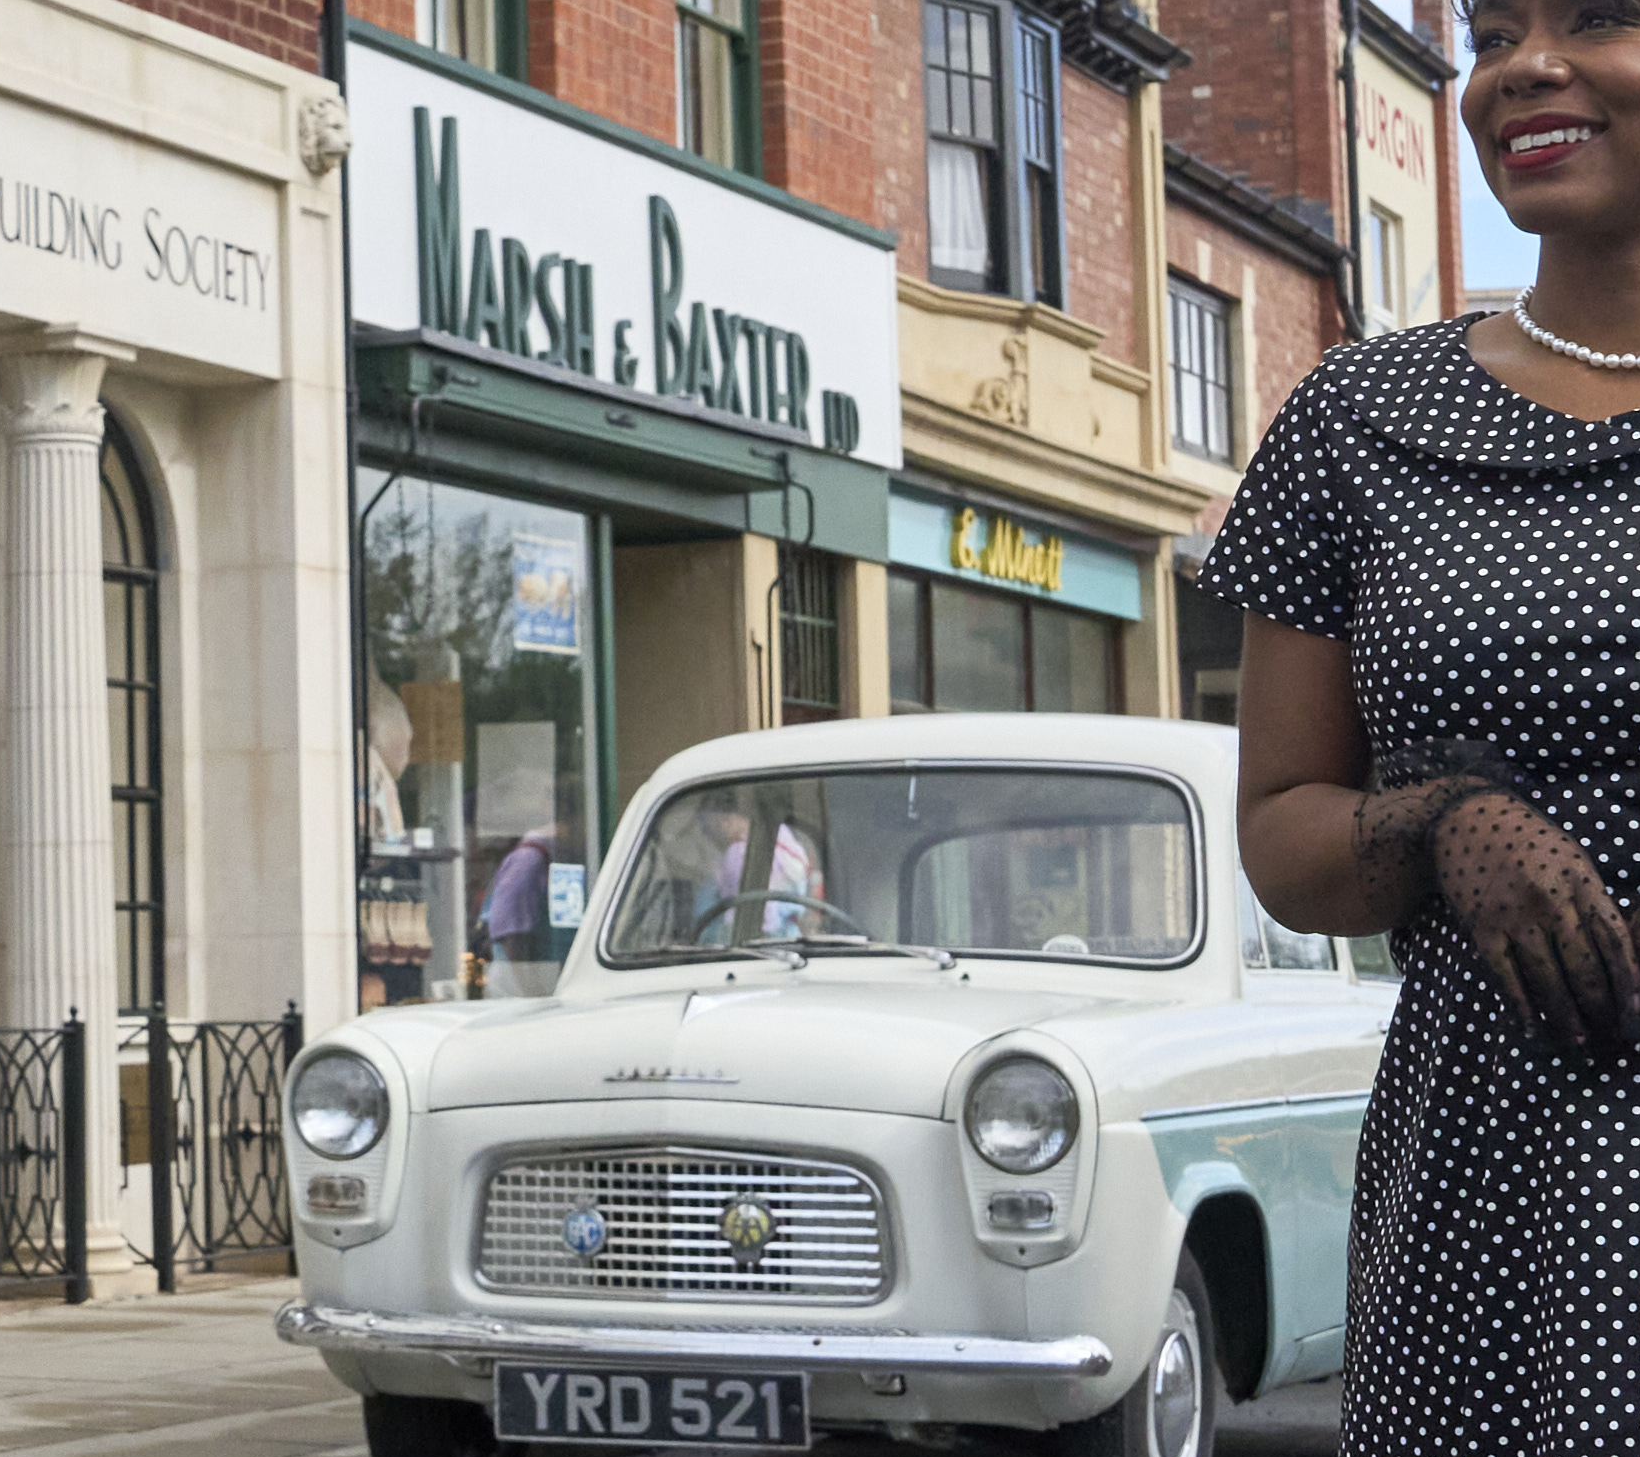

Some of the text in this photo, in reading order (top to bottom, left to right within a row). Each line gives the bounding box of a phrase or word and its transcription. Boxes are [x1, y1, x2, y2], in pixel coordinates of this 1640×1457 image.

[143, 207, 272, 312] SOCIETY
[413, 106, 597, 379] MARSH
[613, 318, 638, 387] &
[648, 195, 810, 432] BAXTER
[522, 1371, 783, 1441] YRD 521
